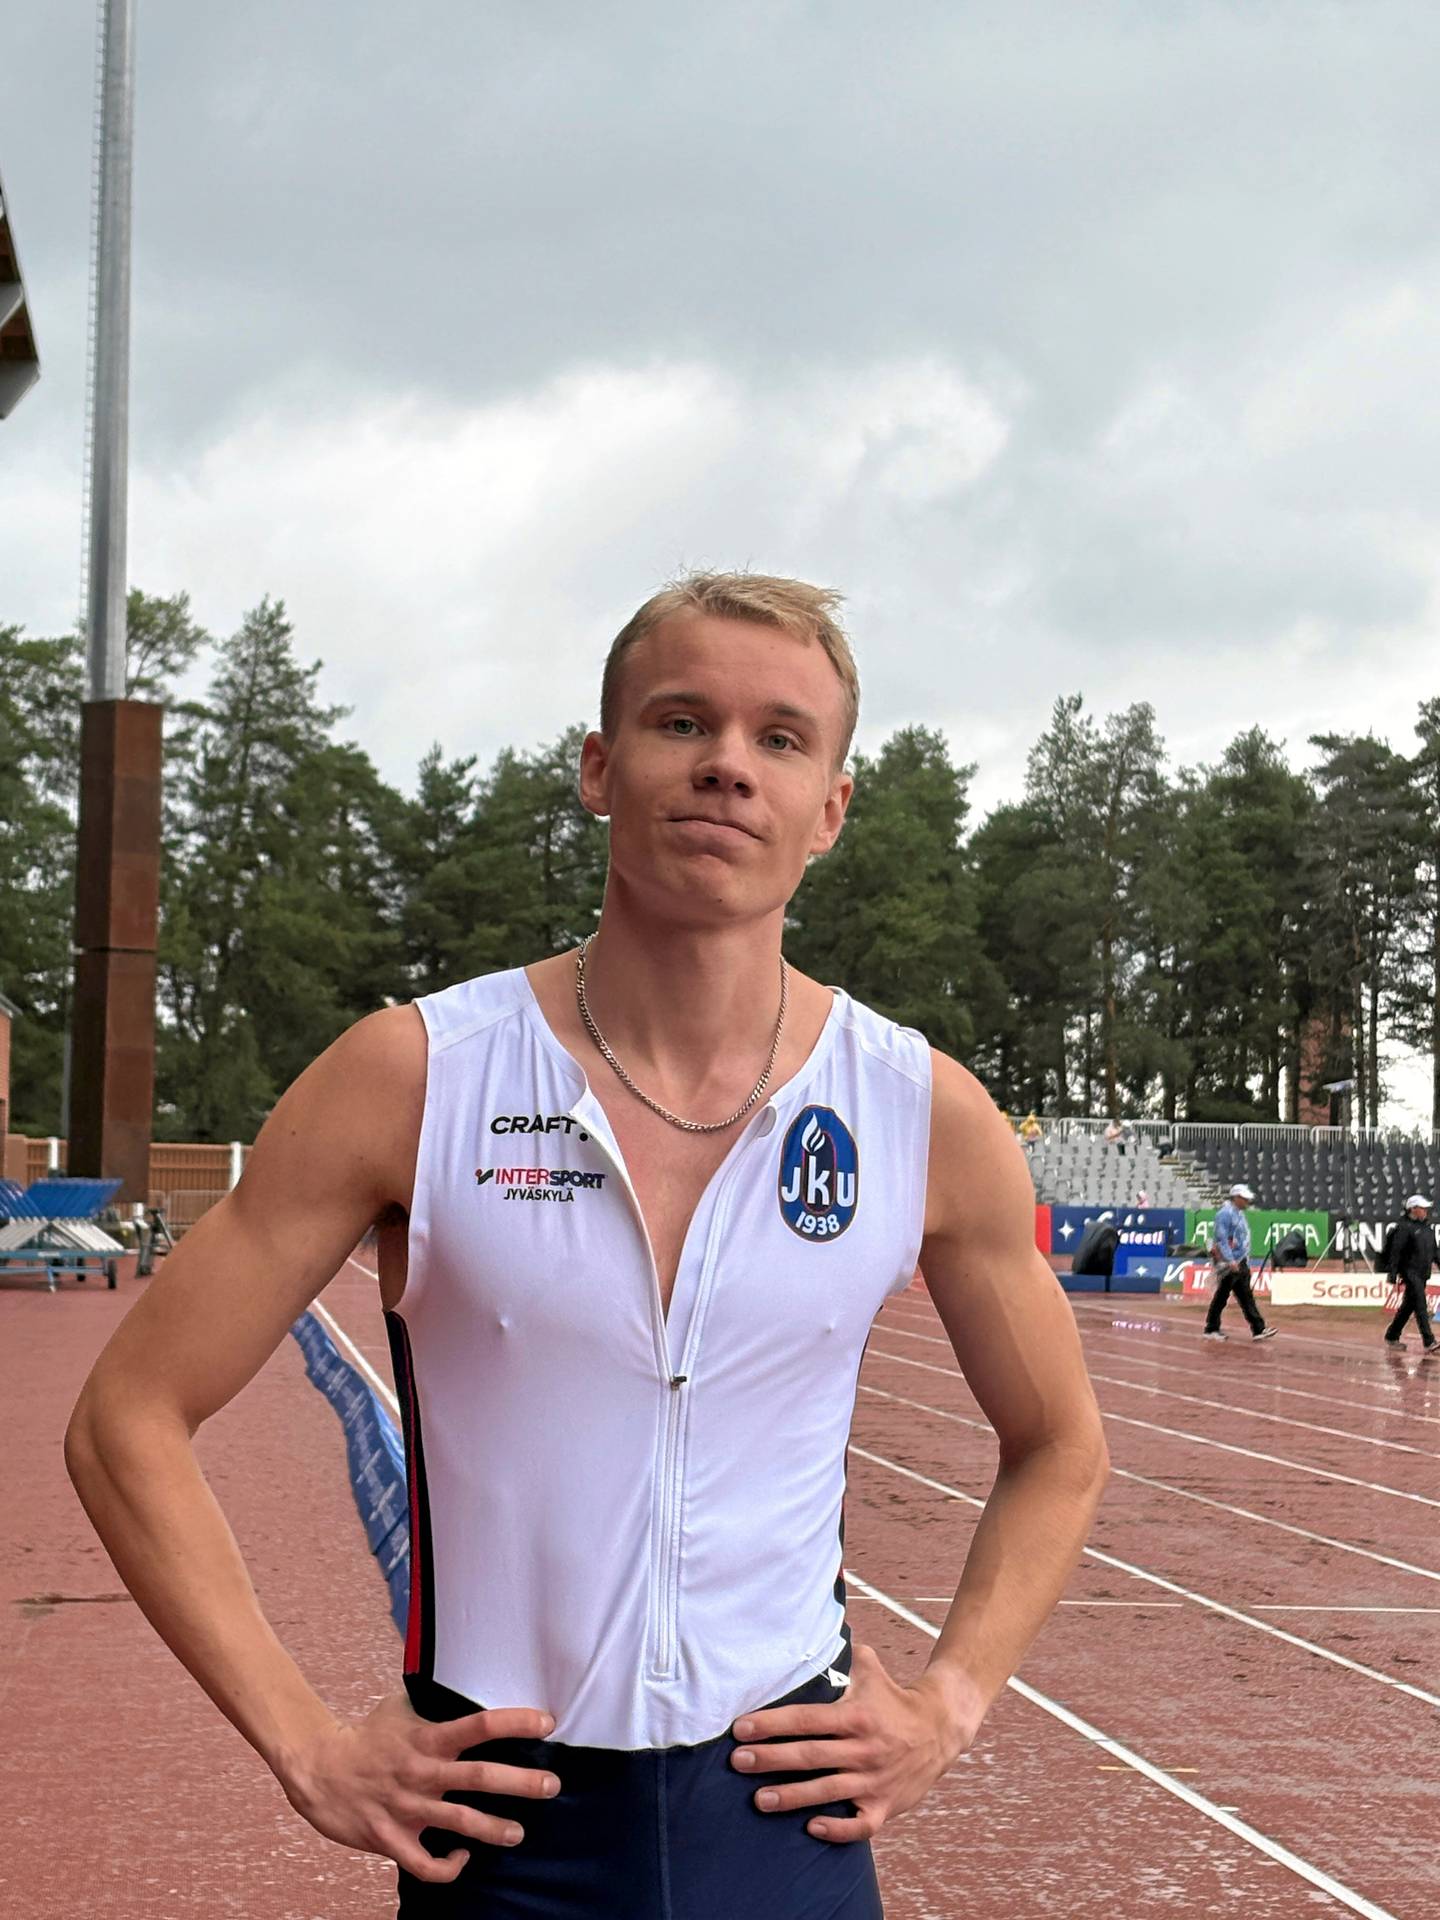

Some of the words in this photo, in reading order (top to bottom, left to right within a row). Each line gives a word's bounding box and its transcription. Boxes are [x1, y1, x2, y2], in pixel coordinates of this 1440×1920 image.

[490, 1114, 577, 1134] CRAFT
[496, 1168, 605, 1189] INTERSPORT
[504, 1187, 574, 1202] JYVÄSKYLÄ
[795, 1211, 840, 1235] 1938
